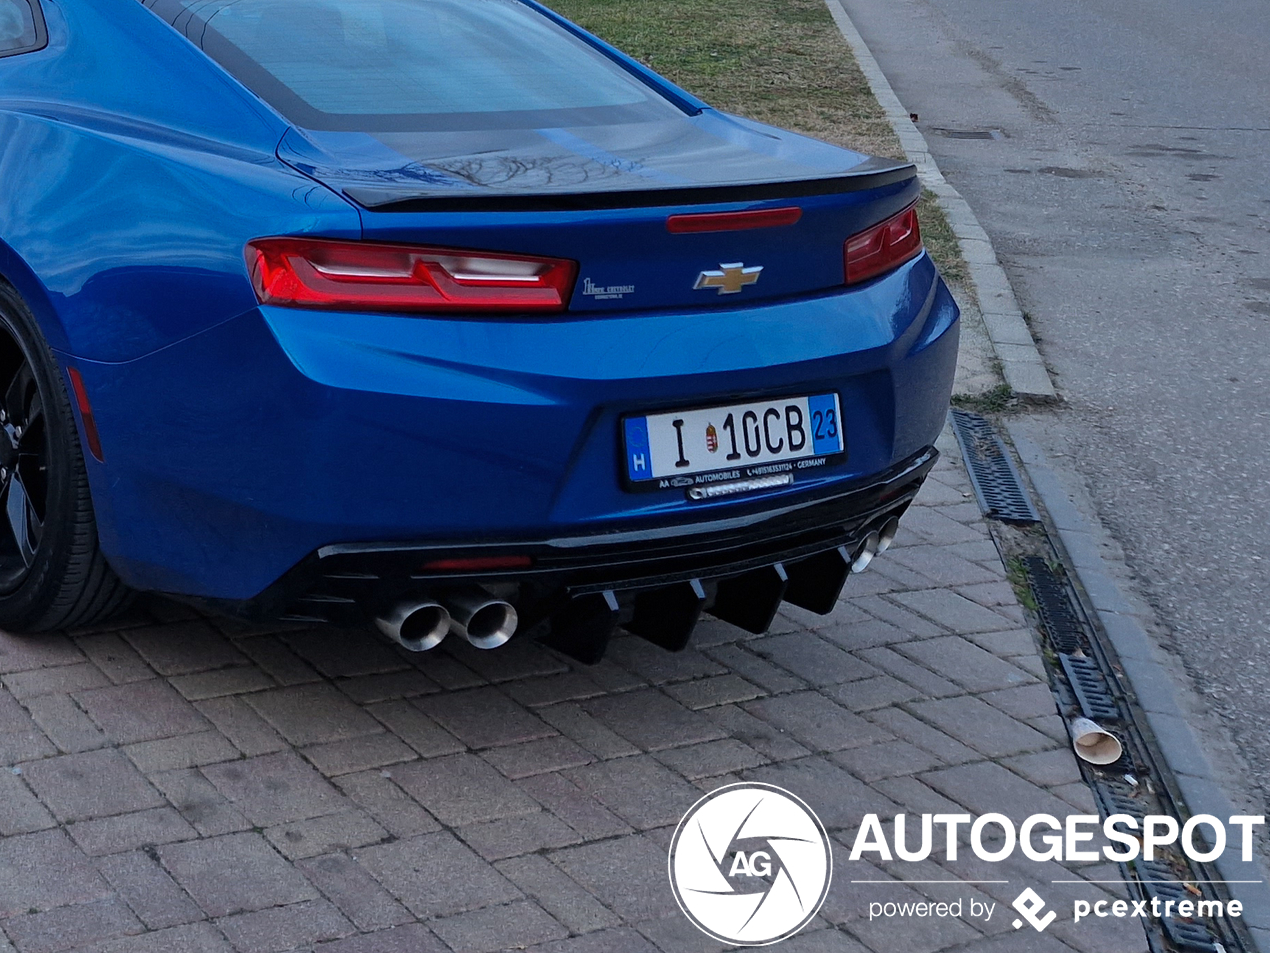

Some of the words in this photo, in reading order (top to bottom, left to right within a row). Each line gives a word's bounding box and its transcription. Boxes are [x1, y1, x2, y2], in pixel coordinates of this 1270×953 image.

[812, 408, 838, 440] 23
[632, 452, 646, 471] H
[659, 480, 670, 489] AA
[695, 470, 741, 484] AUTOMOBILES
[796, 458, 827, 469] GERMANY
